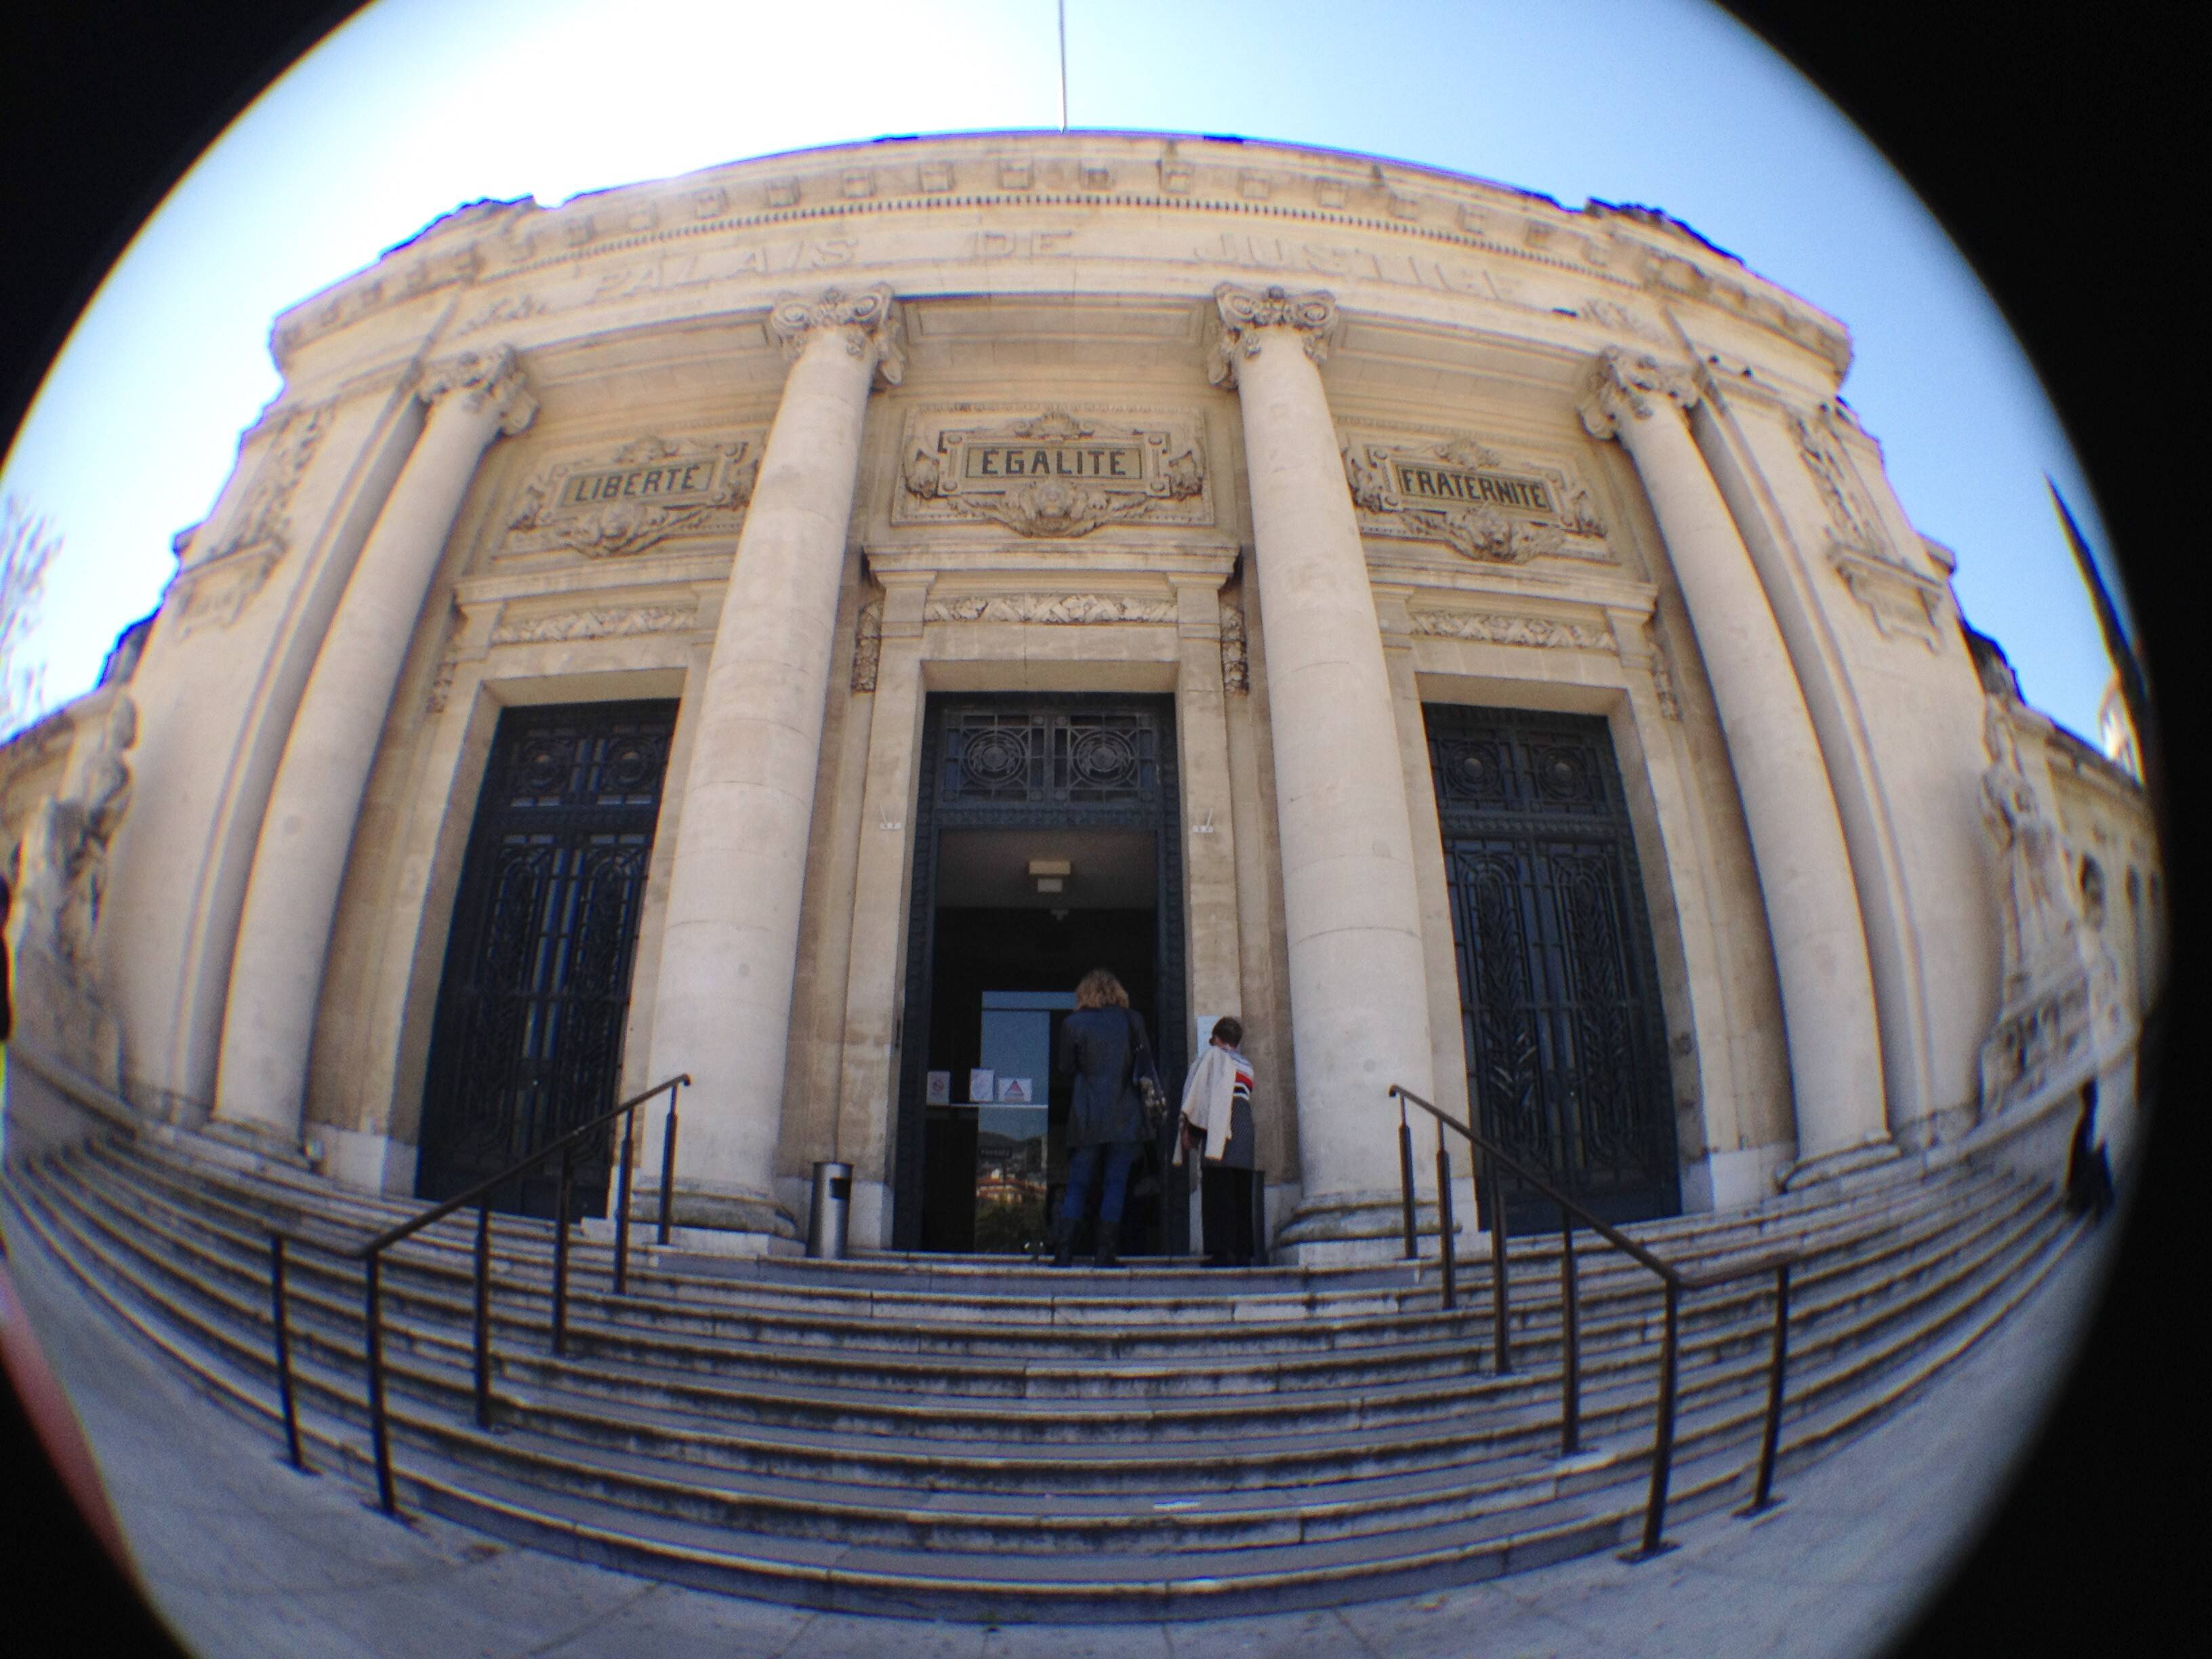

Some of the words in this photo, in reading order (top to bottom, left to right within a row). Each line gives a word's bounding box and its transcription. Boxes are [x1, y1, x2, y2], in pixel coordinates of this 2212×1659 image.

[586, 236, 859, 301] PALAIS
[973, 230, 1073, 259] DE
[982, 449, 1126, 476] EGALITE
[575, 464, 701, 501] LIBERTE
[1401, 468, 1549, 509] FRATERNITE
